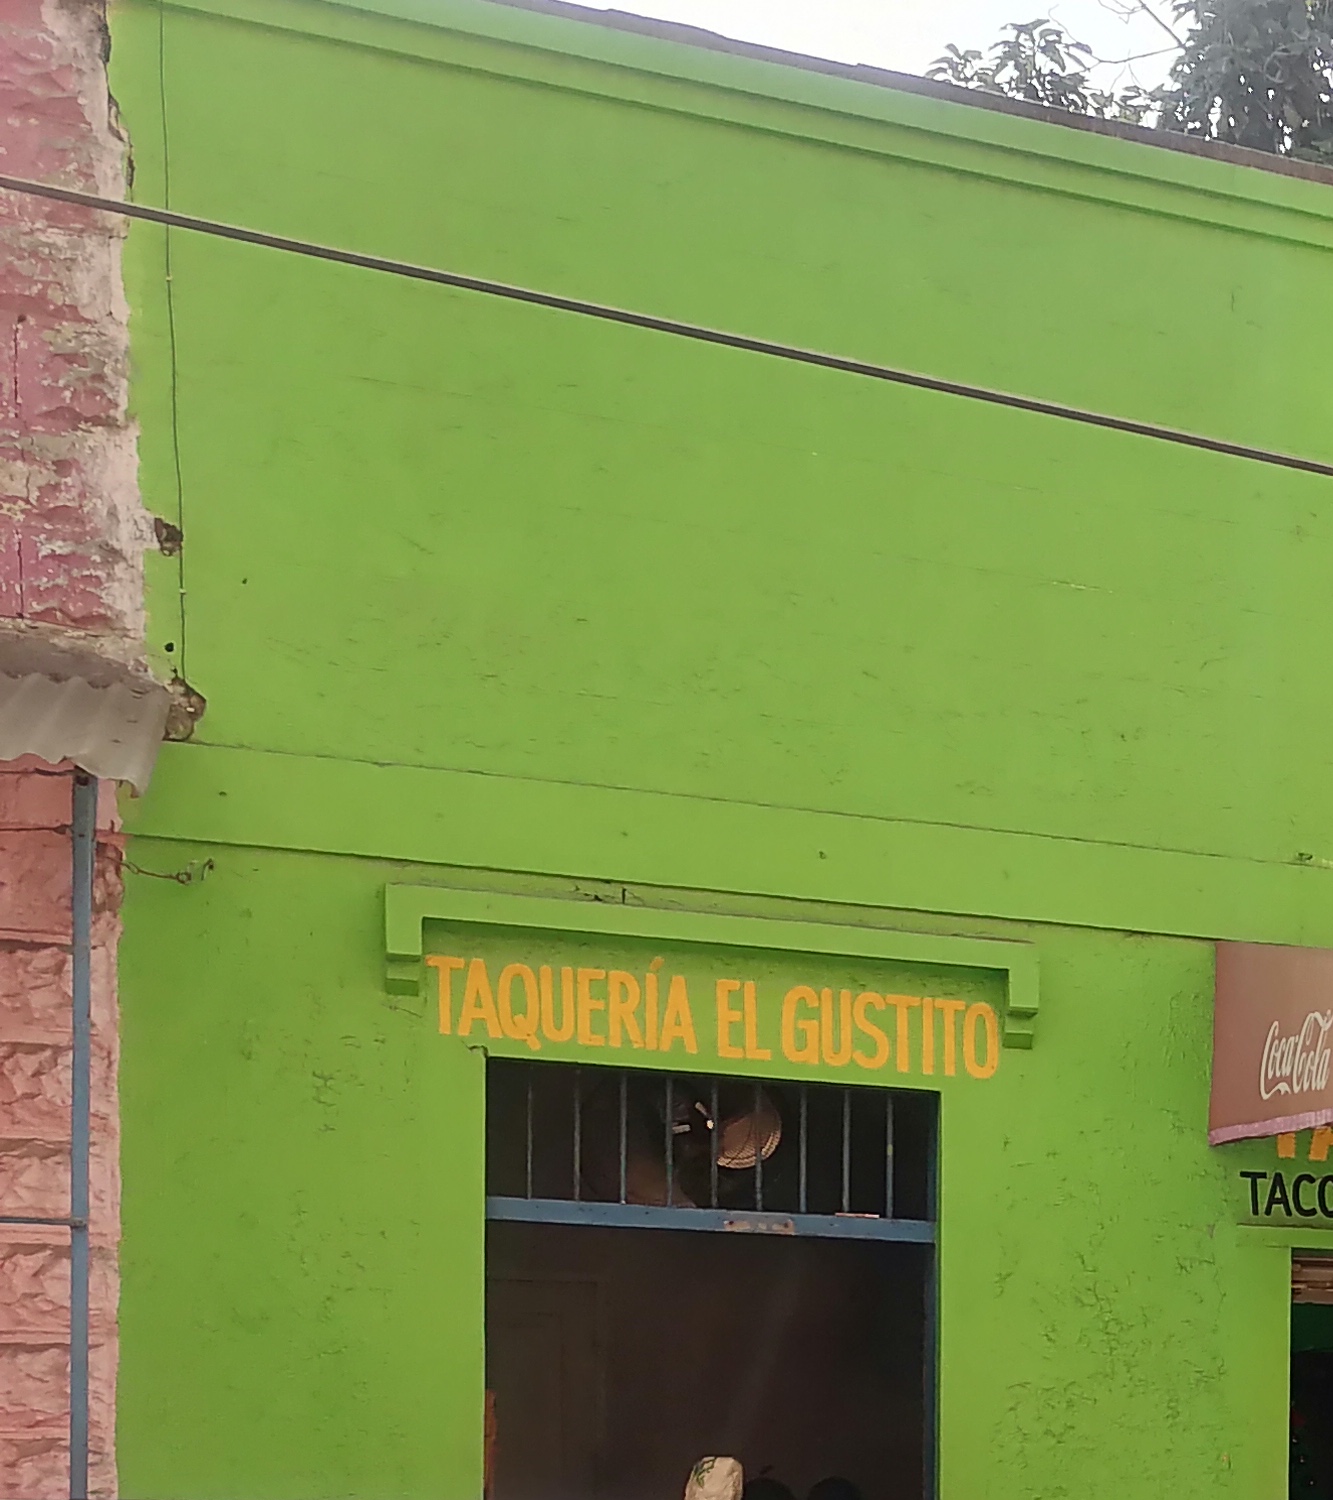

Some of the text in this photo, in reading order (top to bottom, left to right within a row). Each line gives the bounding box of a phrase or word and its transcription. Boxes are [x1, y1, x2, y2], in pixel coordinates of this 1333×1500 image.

[426, 955, 999, 1079] TAQUERÍA EL GUSTITO
